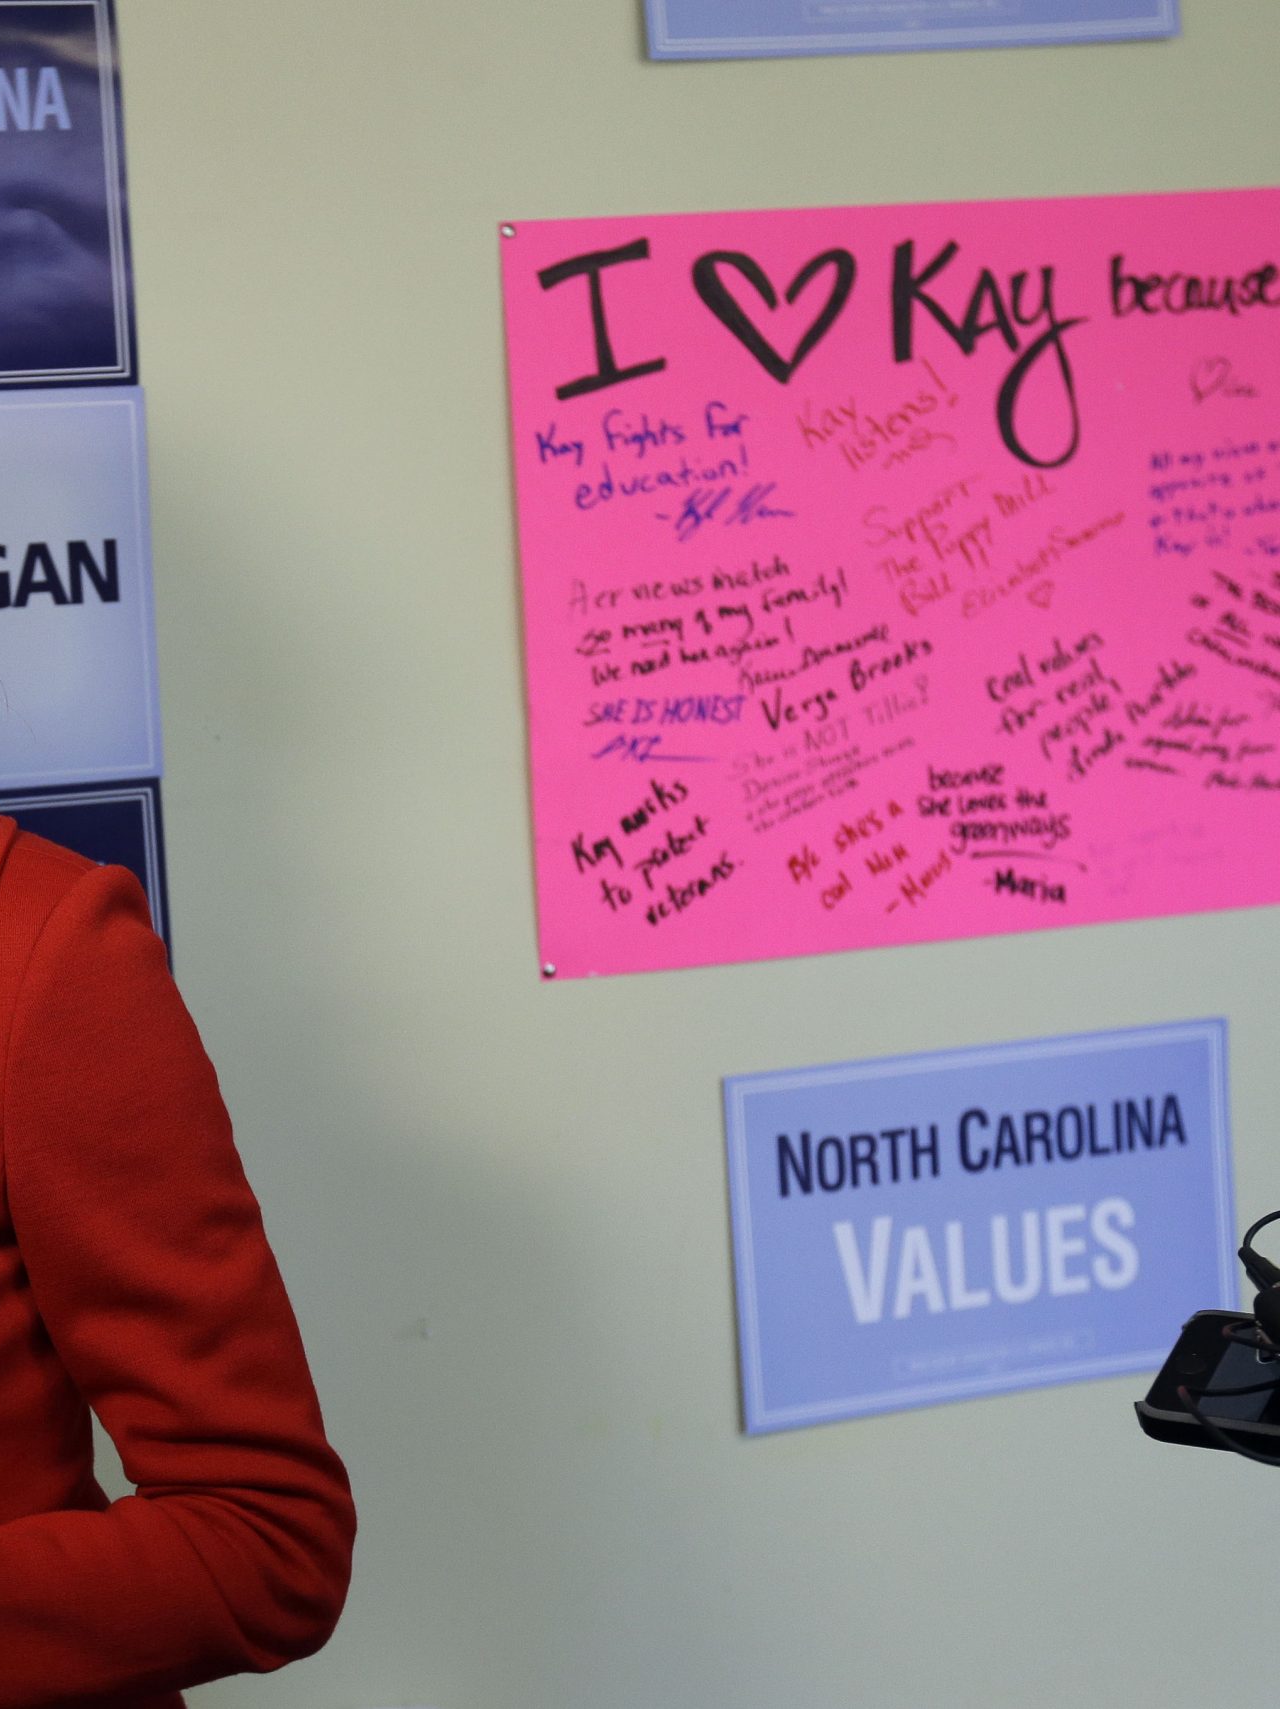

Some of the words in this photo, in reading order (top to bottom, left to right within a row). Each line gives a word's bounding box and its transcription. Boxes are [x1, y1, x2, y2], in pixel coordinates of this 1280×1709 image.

[537, 237, 667, 401] I
[536, 421, 584, 466] Kay
[576, 444, 749, 510] education!
[660, 695, 747, 725] HONEST
[571, 833, 623, 873] Kay
[776, 1124, 940, 1199] NORTH
[958, 1095, 1188, 1174] CAROLINA
[833, 1196, 1140, 1325] VALUES
